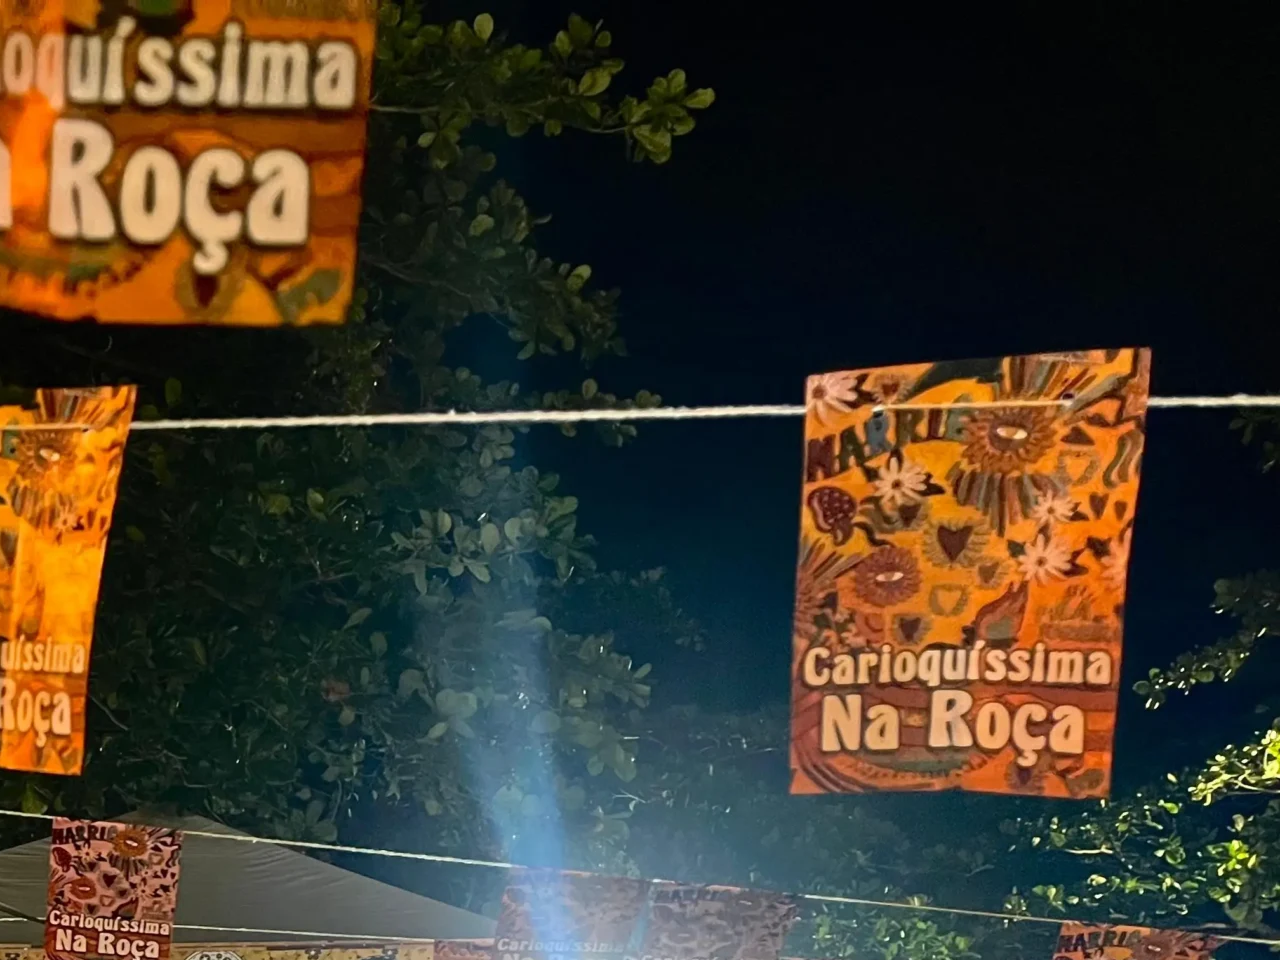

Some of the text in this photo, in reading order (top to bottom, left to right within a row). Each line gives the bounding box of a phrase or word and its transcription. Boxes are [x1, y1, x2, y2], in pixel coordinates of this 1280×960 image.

[49, 118, 310, 274] Roça
[803, 639, 1112, 686] Carioquíssima
[821, 690, 1085, 767] Na Roça
[49, 910, 170, 936] Carioquíssima
[56, 929, 87, 952] Na
